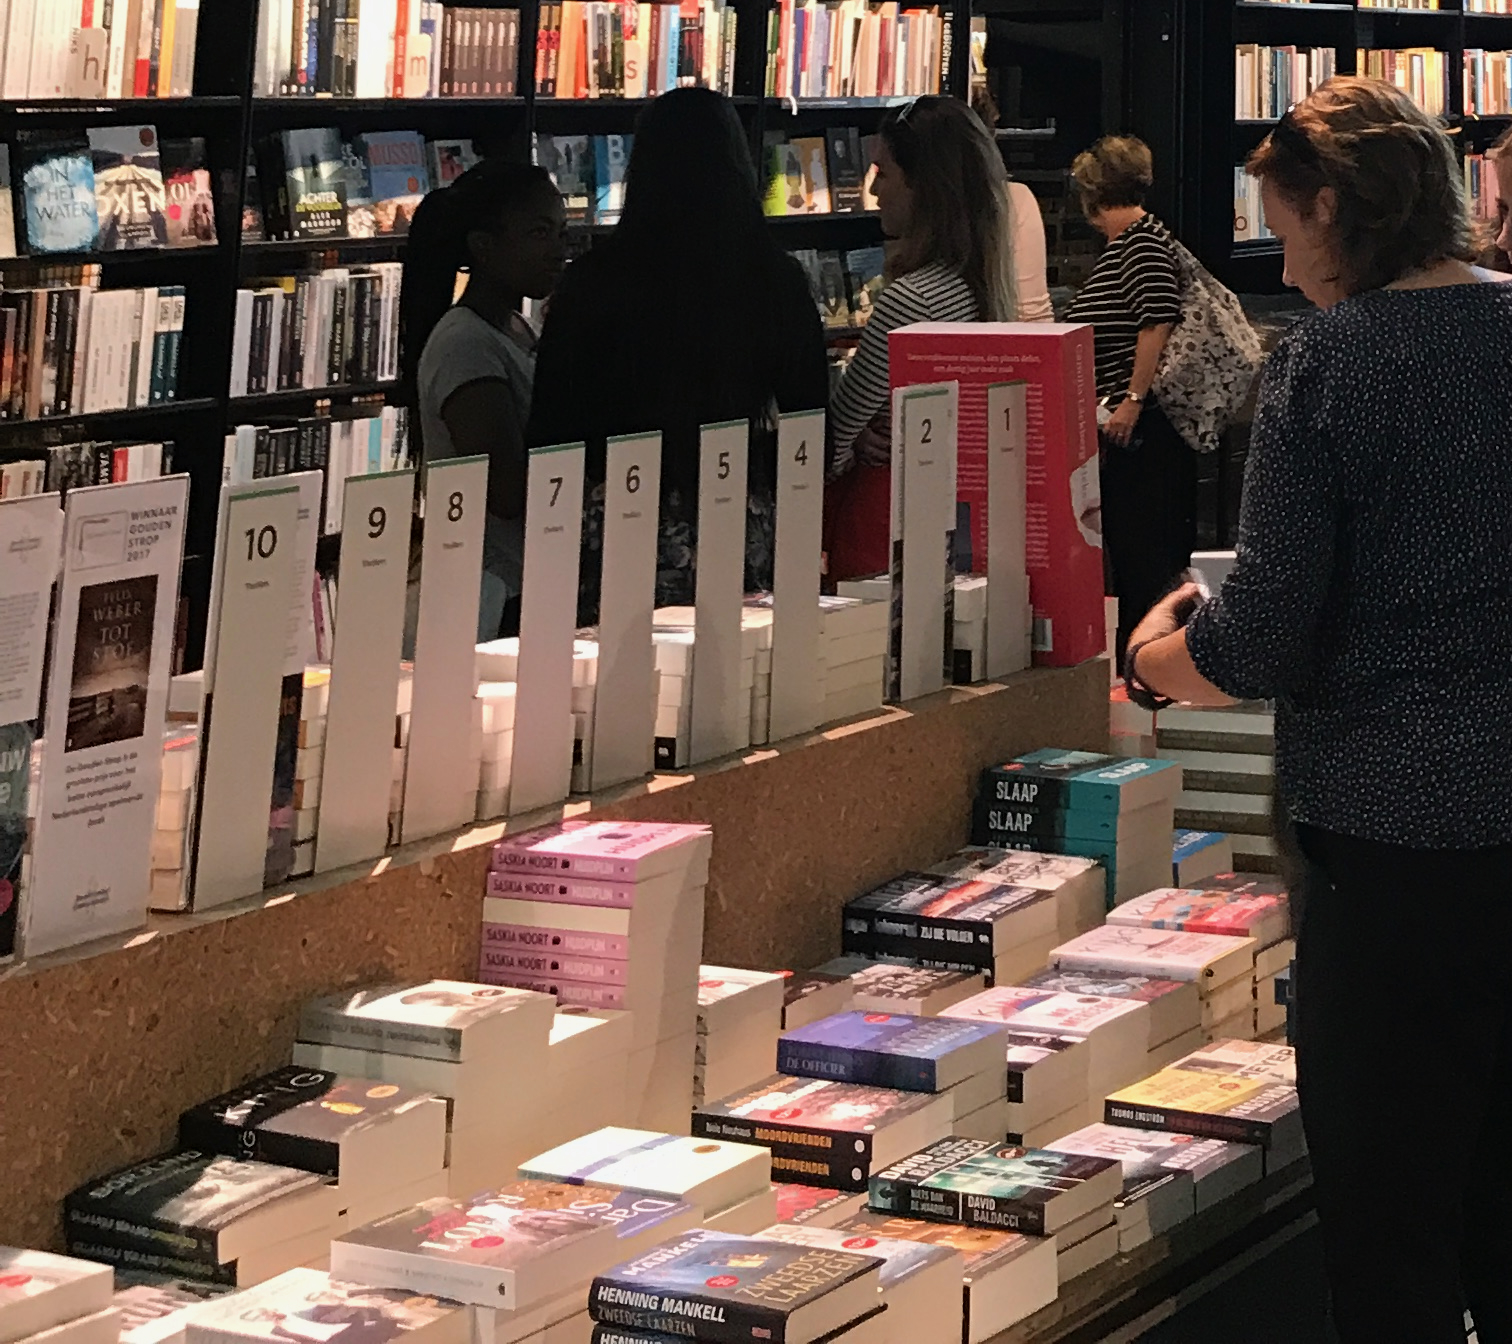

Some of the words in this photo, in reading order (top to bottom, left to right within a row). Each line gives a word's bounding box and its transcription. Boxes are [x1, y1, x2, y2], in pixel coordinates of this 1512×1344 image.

[83, 44, 99, 81] h
[410, 55, 427, 75] m
[49, 168, 69, 183] IN
[46, 183, 76, 202] HET
[35, 201, 91, 222] WATER
[920, 418, 933, 444] 2
[1003, 407, 1011, 432] 1
[794, 439, 808, 466] 4
[717, 451, 731, 480] 5
[625, 464, 641, 494] 6
[549, 476, 564, 507] 7
[130, 505, 178, 521] WINNAAR
[447, 491, 464, 522] 8
[129, 520, 172, 535] GOUDEN
[367, 506, 387, 539] 9
[127, 534, 160, 549] STROP
[244, 524, 278, 562] 10
[127, 550, 151, 562] 2017
[92, 600, 142, 622] WEBER
[101, 623, 132, 644] TOT
[996, 780, 1038, 803] SLAAP
[988, 810, 1032, 832] SLAAP
[498, 852, 527, 865] SASKIA
[528, 854, 558, 869] NOORT
[493, 878, 523, 893] SASKIA
[525, 881, 555, 896] NOORT
[486, 928, 517, 943] SASKIA
[518, 931, 549, 947] NOORT
[485, 953, 514, 968] SASKIA
[516, 956, 547, 971] NOORT
[754, 1126, 833, 1149] MOORDVRIENDEN
[877, 1153, 934, 1180] DAVID
[910, 1139, 990, 1178] BALDACCI
[967, 1194, 996, 1211] DAVID
[973, 1208, 1019, 1228] BALDACCI
[735, 1249, 836, 1299] ZWEEDSE
[764, 1252, 867, 1304] LAARZEN
[597, 1285, 660, 1310] HENNING
[661, 1296, 726, 1324] MANKELL
[598, 1305, 643, 1327] ZWEEDSE
[645, 1313, 697, 1337] LAARZEN
